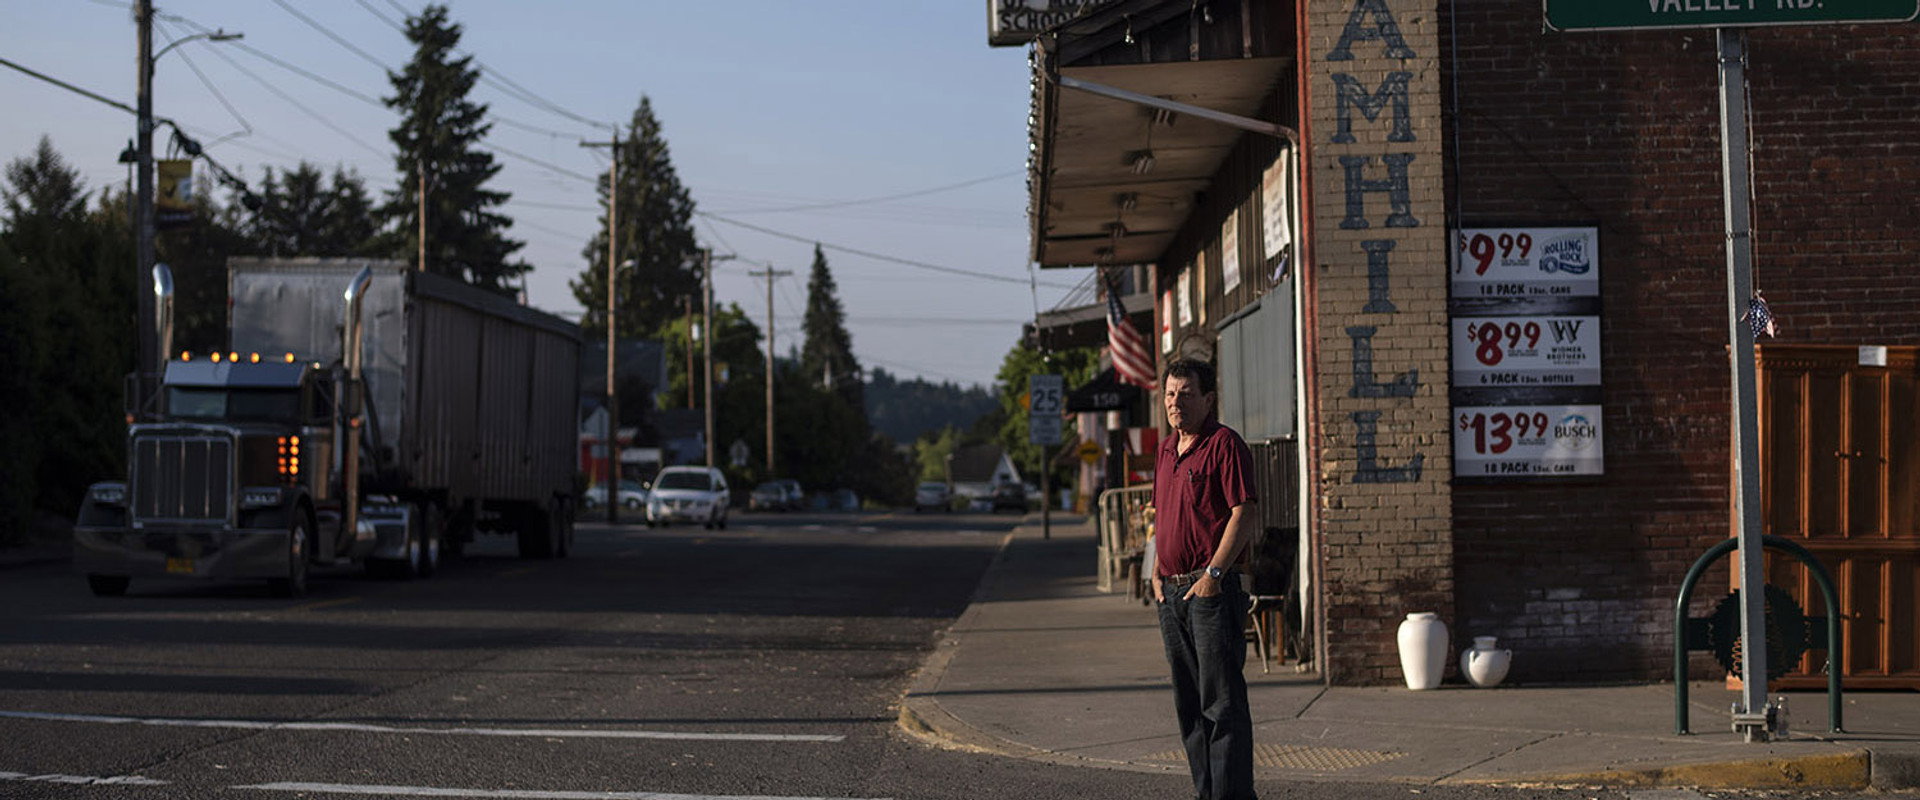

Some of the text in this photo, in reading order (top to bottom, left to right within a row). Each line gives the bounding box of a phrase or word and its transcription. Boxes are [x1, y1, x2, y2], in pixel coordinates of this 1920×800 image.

[1544, 239, 1582, 255] ROLLING
[1559, 252, 1582, 263] ROCK
[1480, 285, 1493, 295] 18
[1497, 284, 1525, 295] PACK
[1550, 286, 1571, 294] CANS
[1480, 374, 1488, 384] 6
[1491, 373, 1519, 384] PACK
[1542, 374, 1574, 383] BOTTLES
[1033, 389, 1059, 412] 25
[1554, 425, 1596, 438] BUSCH
[1484, 463, 1497, 473] 18
[1501, 462, 1529, 473] PACK
[1554, 464, 1575, 473] CANS
